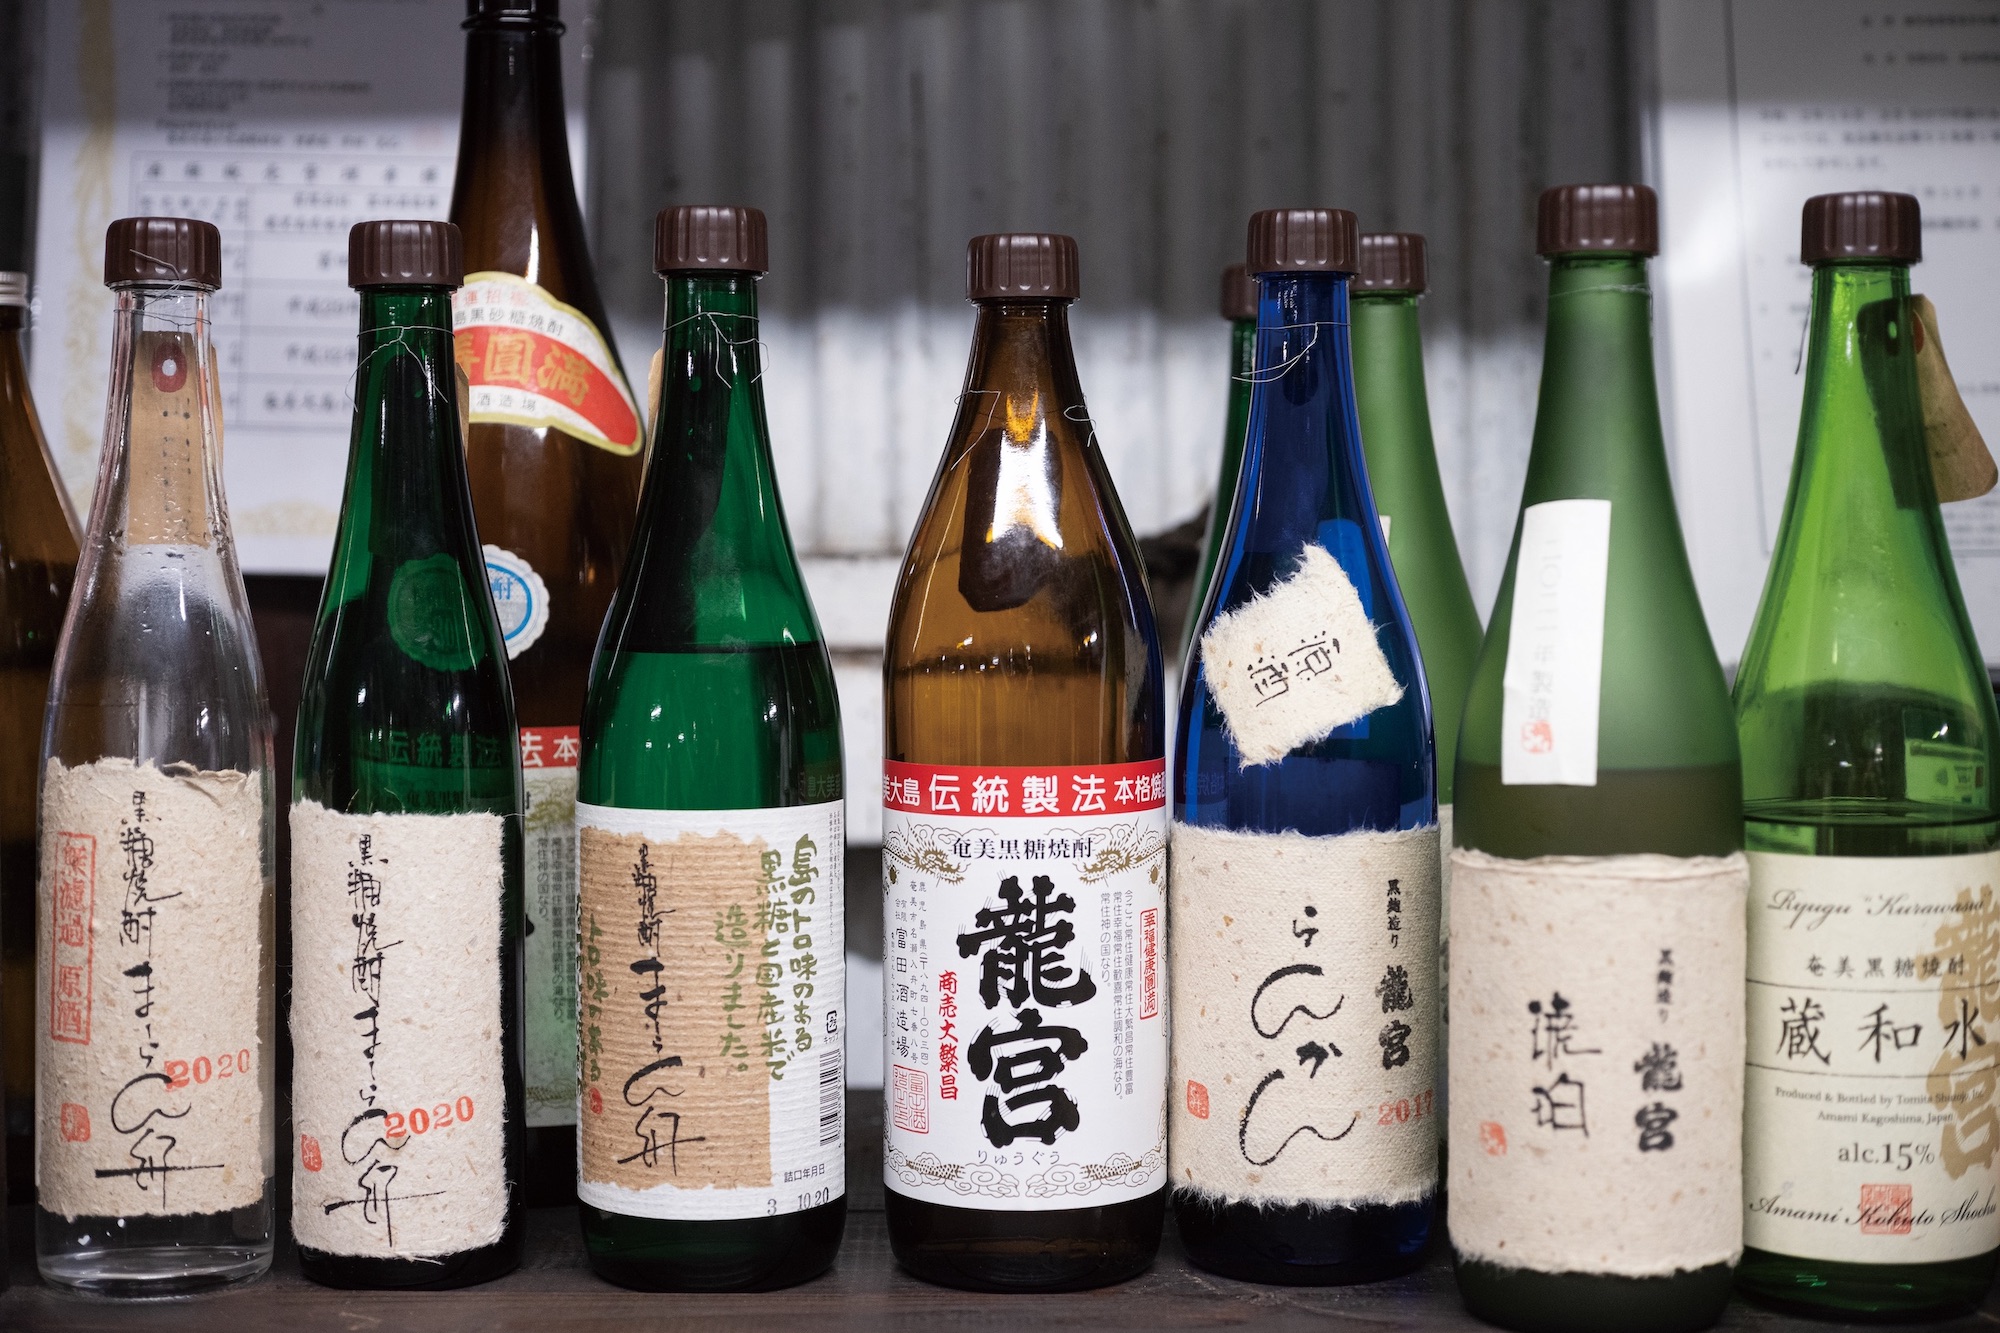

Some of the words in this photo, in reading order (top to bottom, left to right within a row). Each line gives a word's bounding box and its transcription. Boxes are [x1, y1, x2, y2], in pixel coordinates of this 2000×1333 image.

[929, 773, 1107, 814] 伝統製法
[951, 837, 1094, 861] 奄美黒糖焼酎
[752, 849, 795, 1081] 黒糖と国産米で
[1807, 953, 1965, 978] 奄美黒糖焼酎
[957, 874, 1097, 1149] 龍宮
[1777, 997, 1986, 1066] 蔵和水
[938, 969, 960, 1101] 商売大繁昌
[164, 1048, 251, 1092] 2020
[1633, 1039, 1684, 1153] 龍宮
[1775, 1087, 1822, 1101] Produced
[1837, 1092, 1876, 1105] Bottled
[1880, 1096, 1893, 1109] by
[383, 1095, 475, 1140] 2020
[1818, 1110, 1858, 1123] Amami
[1926, 1111, 1953, 1126] Japan
[783, 1163, 825, 1183] 詰口年月日
[976, 1149, 1061, 1166] りゅうぐう
[1749, 1195, 1842, 1223] Amami
